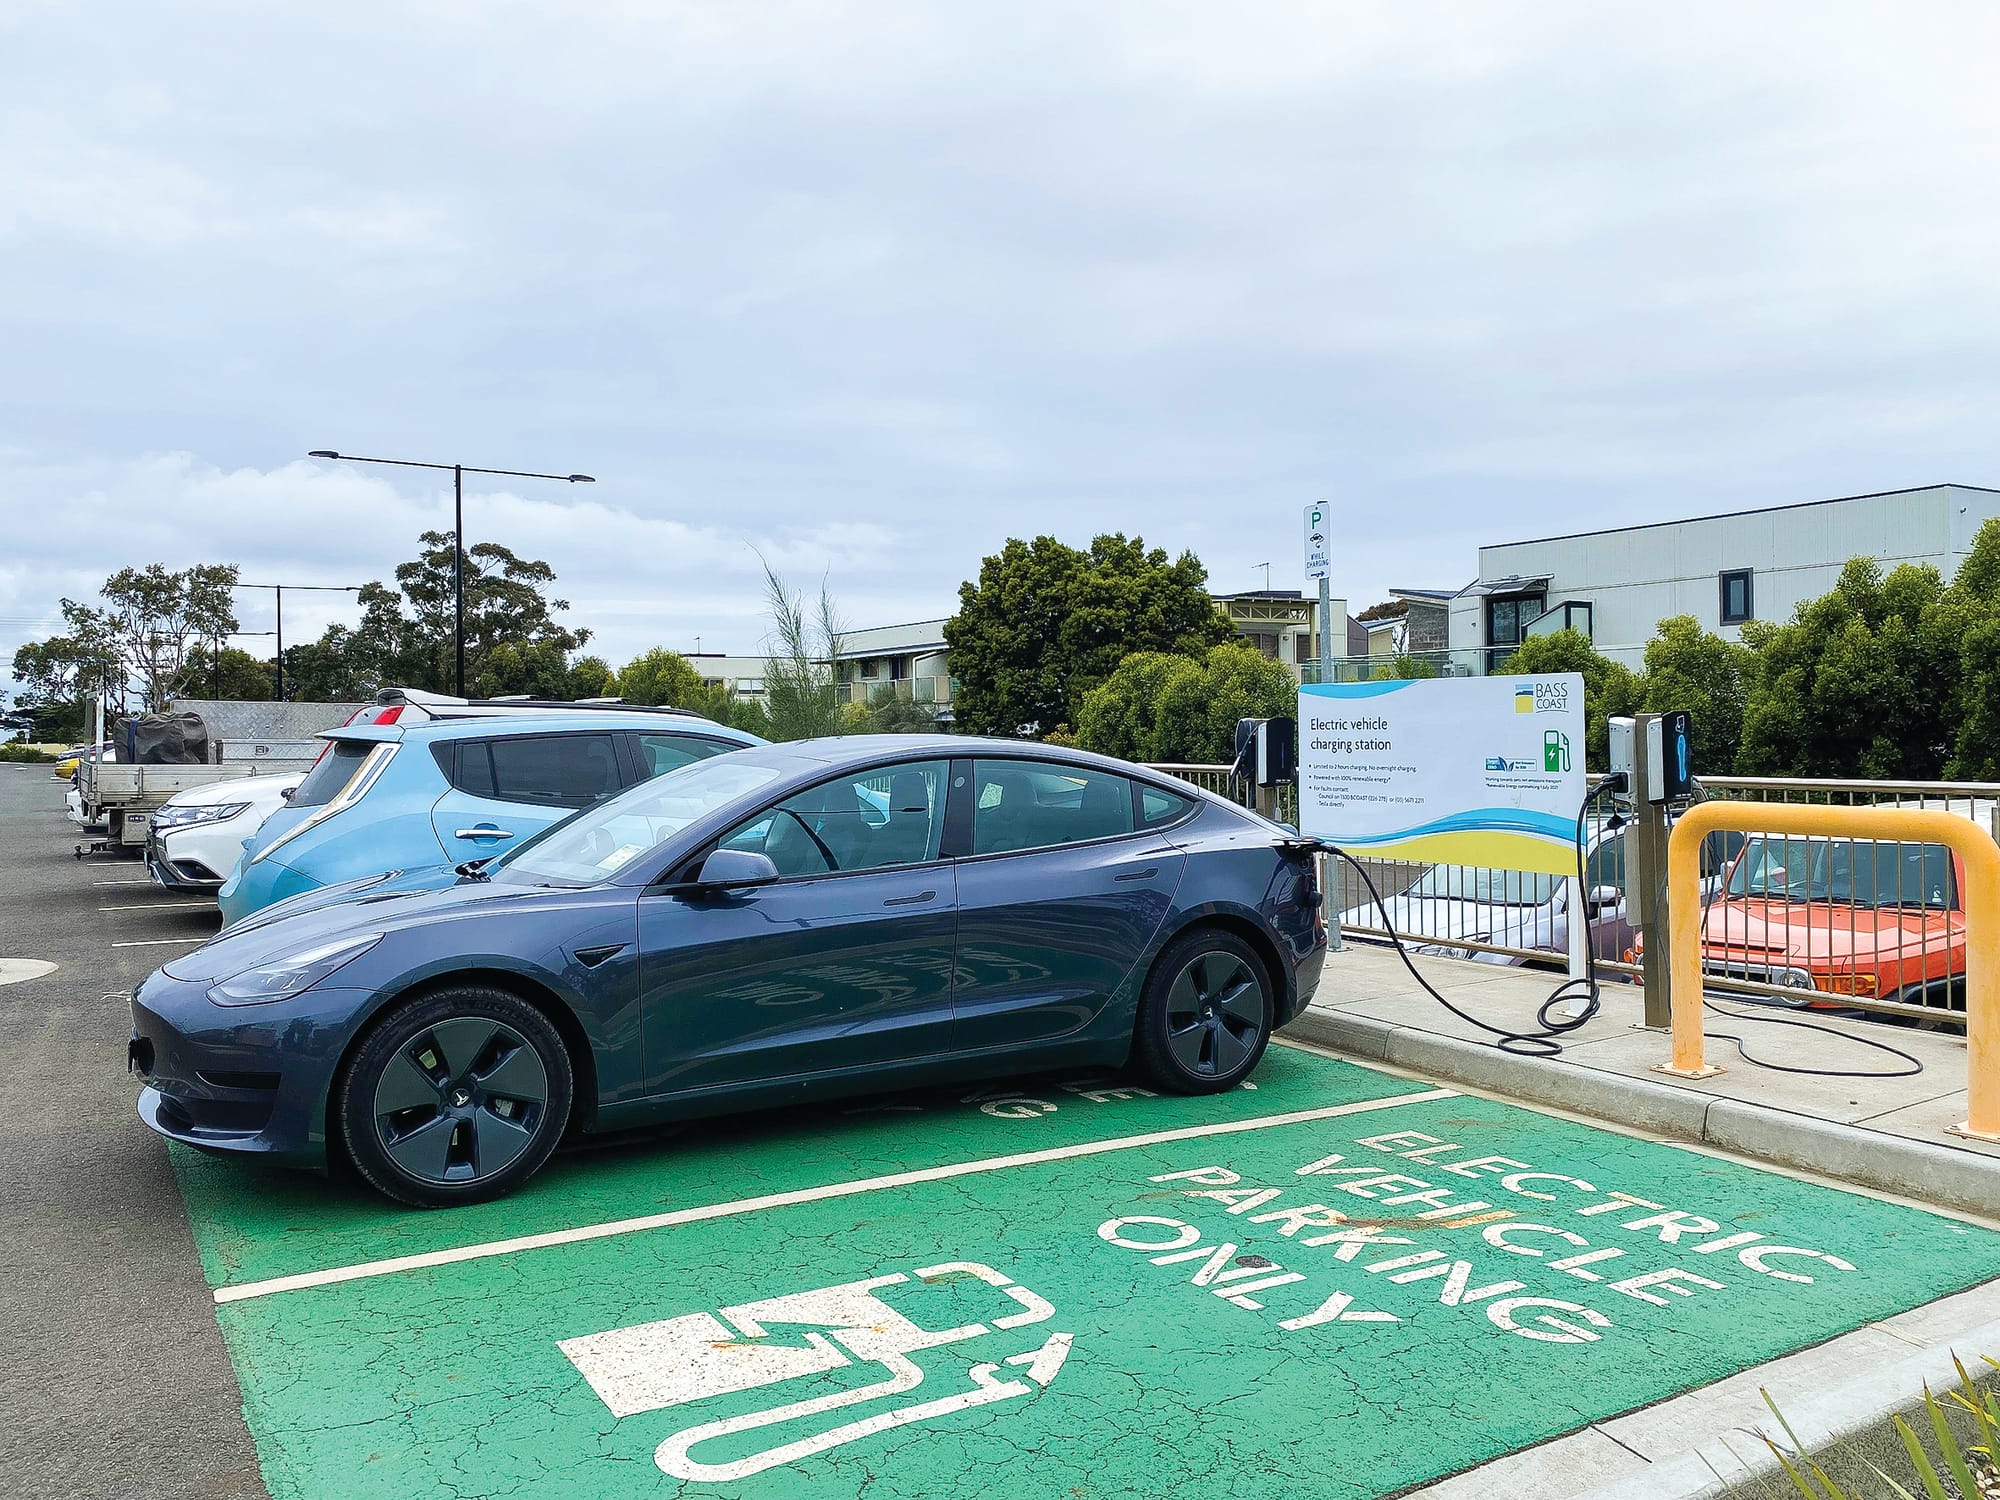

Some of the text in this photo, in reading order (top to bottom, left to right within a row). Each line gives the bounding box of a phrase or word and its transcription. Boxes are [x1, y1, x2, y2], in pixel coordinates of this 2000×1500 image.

[1312, 512, 1322, 530] P
[1536, 682, 1568, 698] BASS
[1536, 698, 1568, 709] COAST
[1310, 717, 1388, 730] Electric vehicle
[1310, 737, 1392, 754] charging station
[1355, 1130, 1858, 1285] ELECTRIC
[1294, 1153, 1727, 1307] VEHICLE
[1148, 1165, 1611, 1344] PARKING
[1096, 1214, 1402, 1332] ONLY
